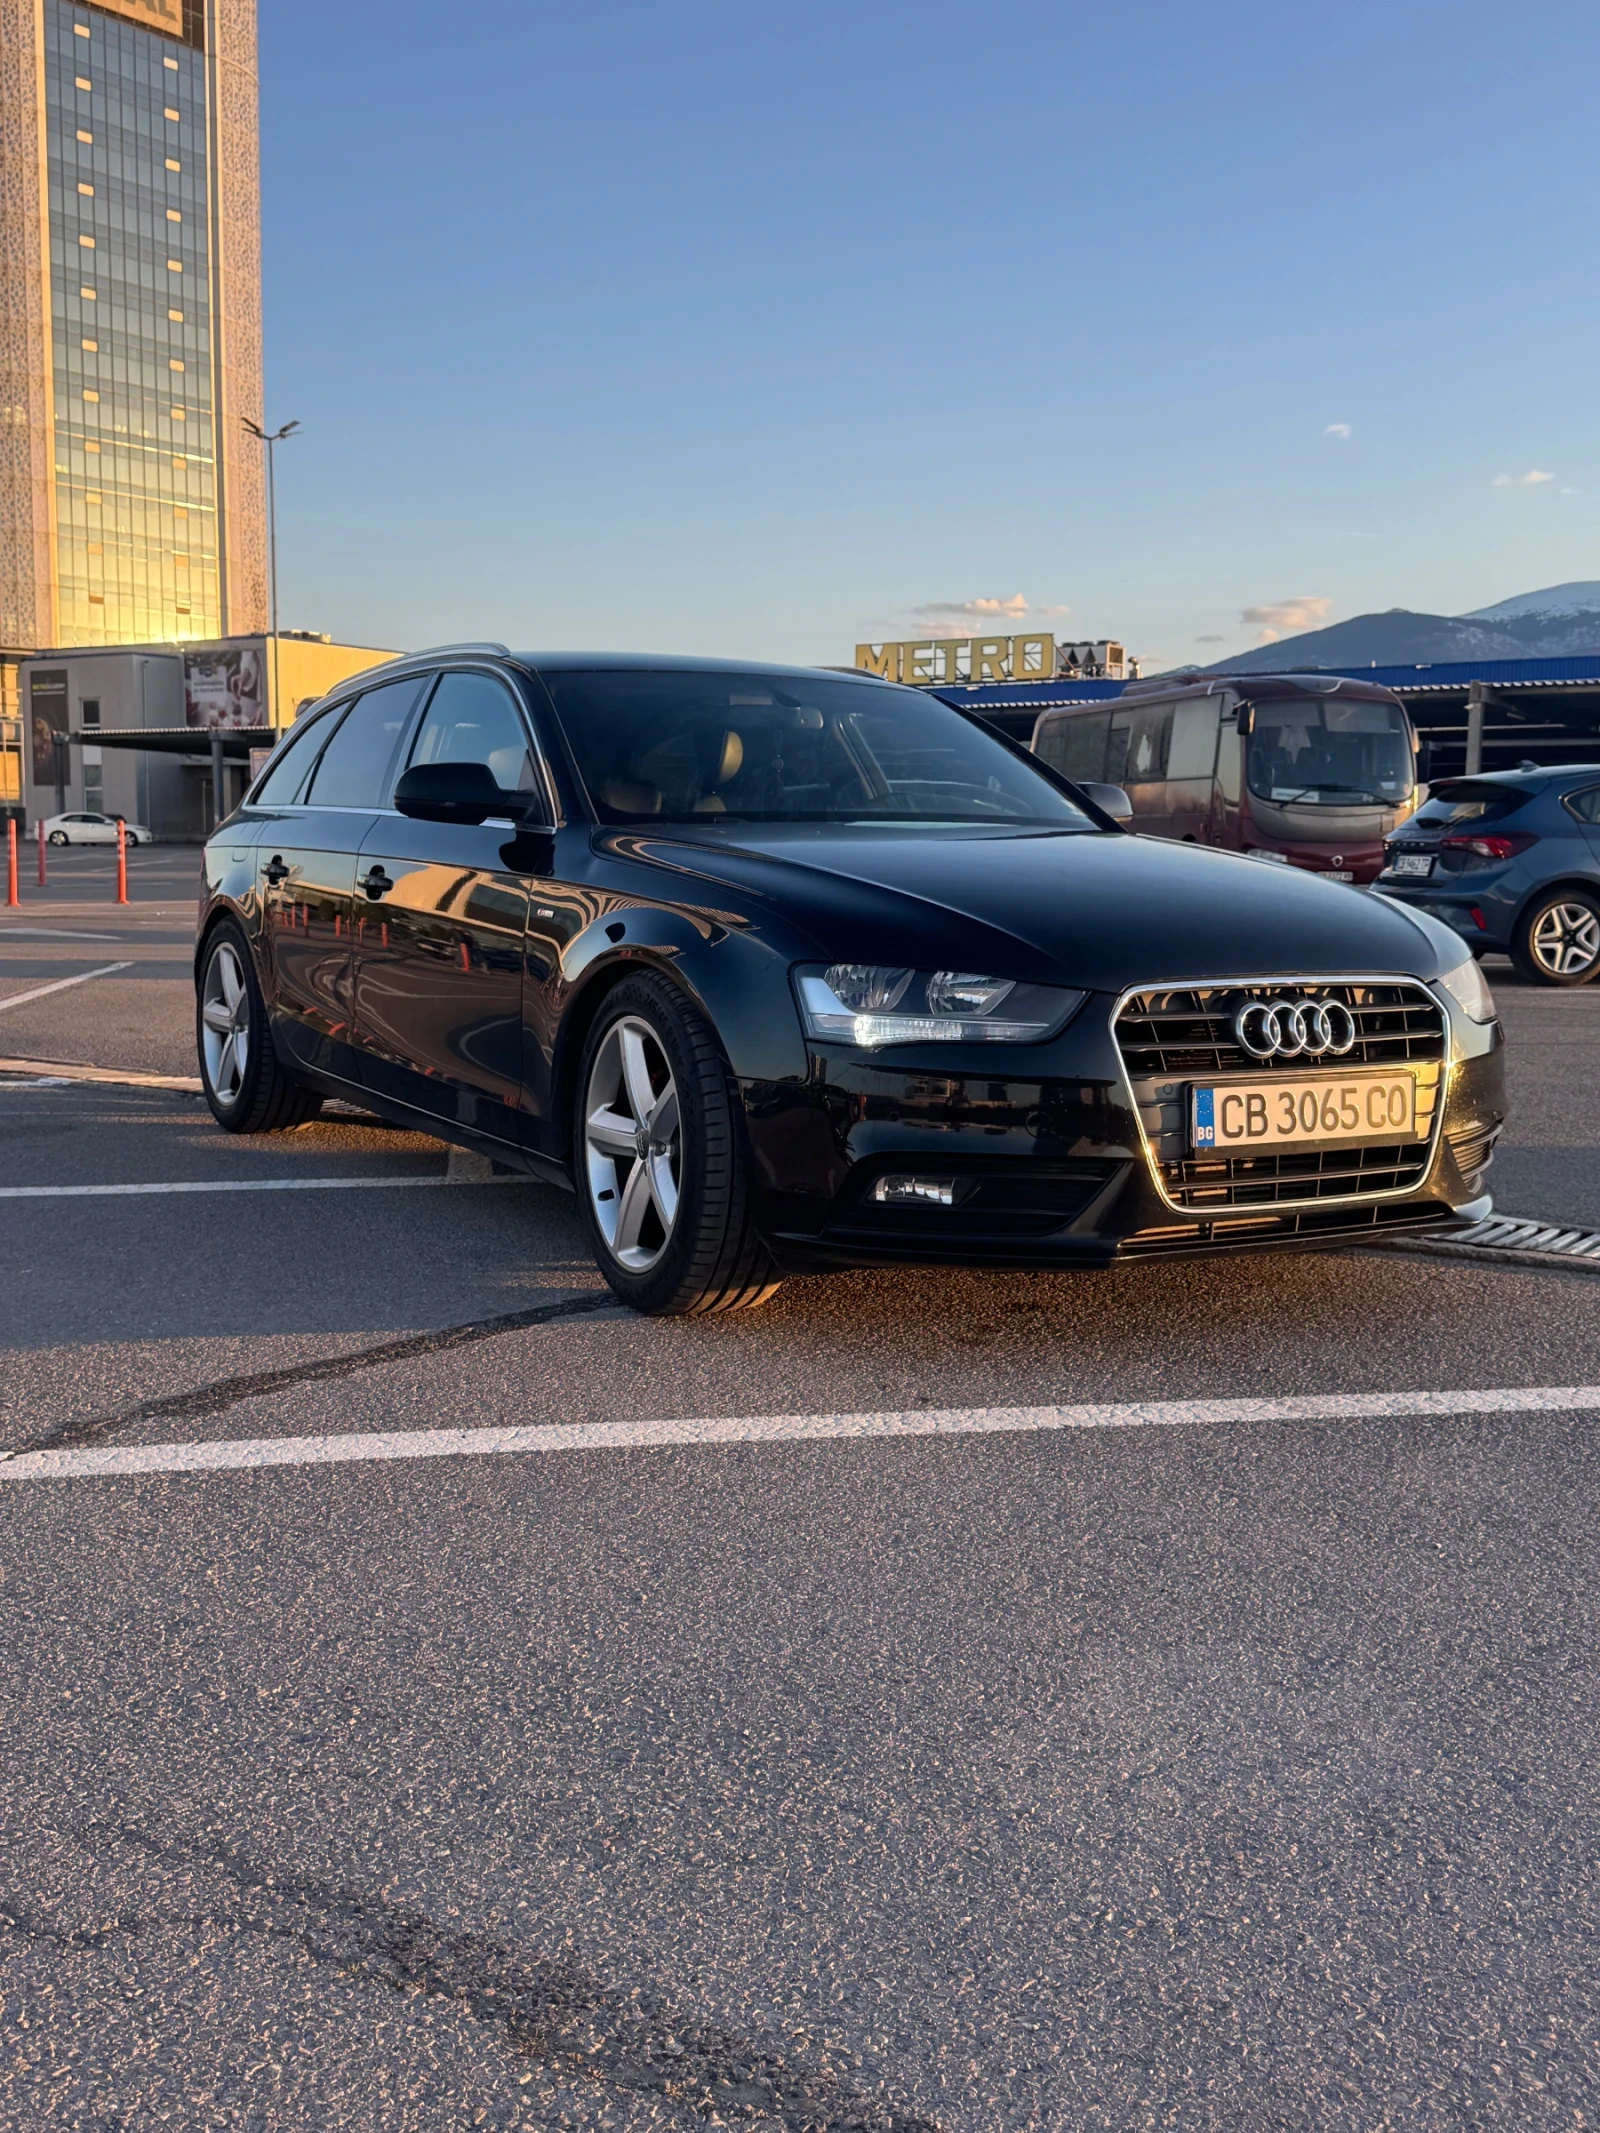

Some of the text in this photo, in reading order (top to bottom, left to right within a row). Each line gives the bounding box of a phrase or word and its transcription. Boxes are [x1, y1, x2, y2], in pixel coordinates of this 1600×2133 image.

[856, 634, 1053, 684] METRO
[1197, 1126, 1213, 1141] BG
[1222, 1085, 1407, 1138] CB 3065 CO
